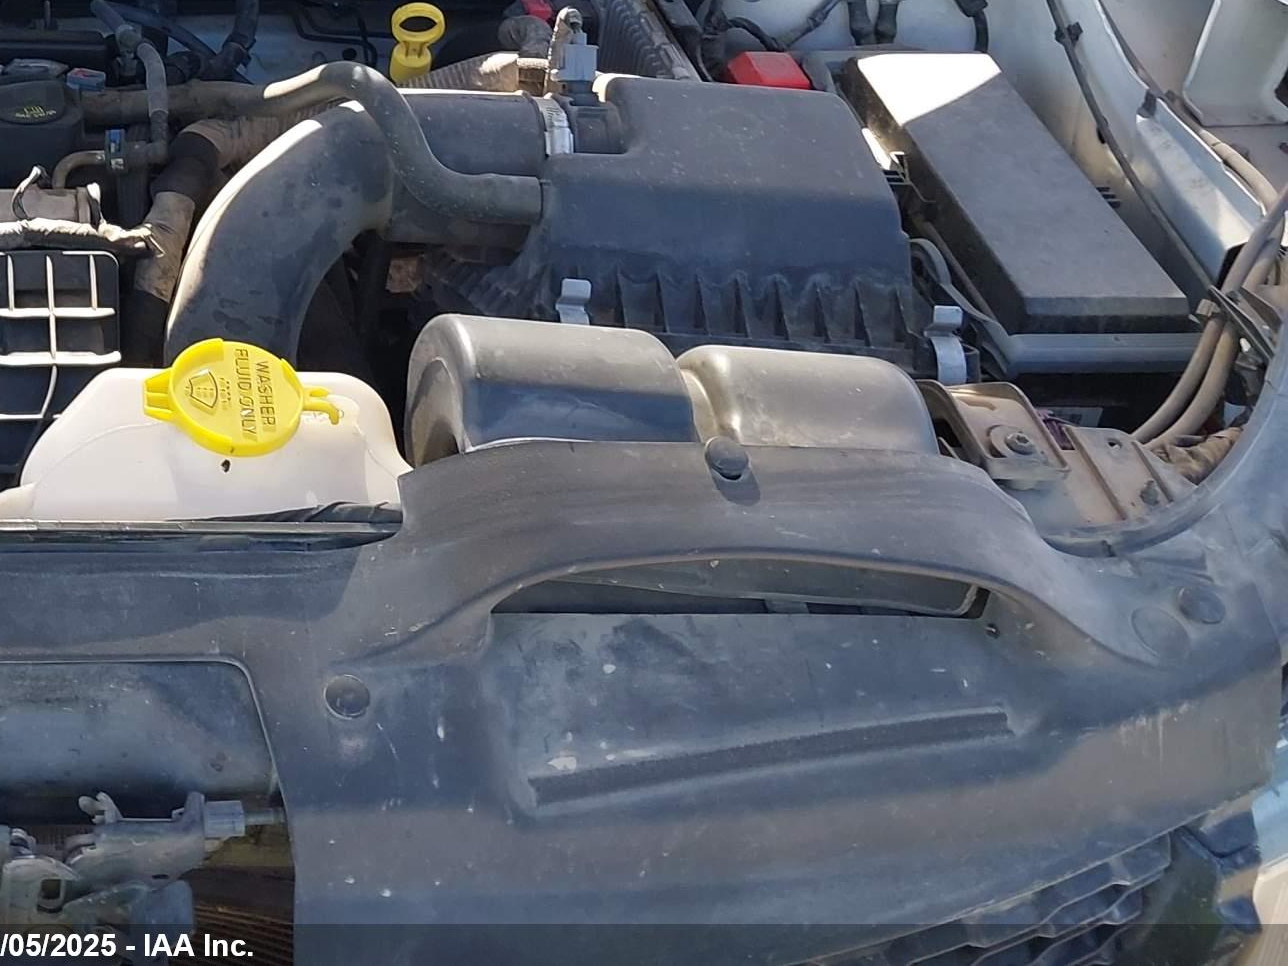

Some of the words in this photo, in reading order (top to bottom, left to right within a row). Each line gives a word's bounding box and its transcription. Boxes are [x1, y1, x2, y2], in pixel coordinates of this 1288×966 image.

[234, 347, 252, 393] FLUID
[239, 396, 257, 435] ONLY
[255, 360, 276, 427] WASHER
